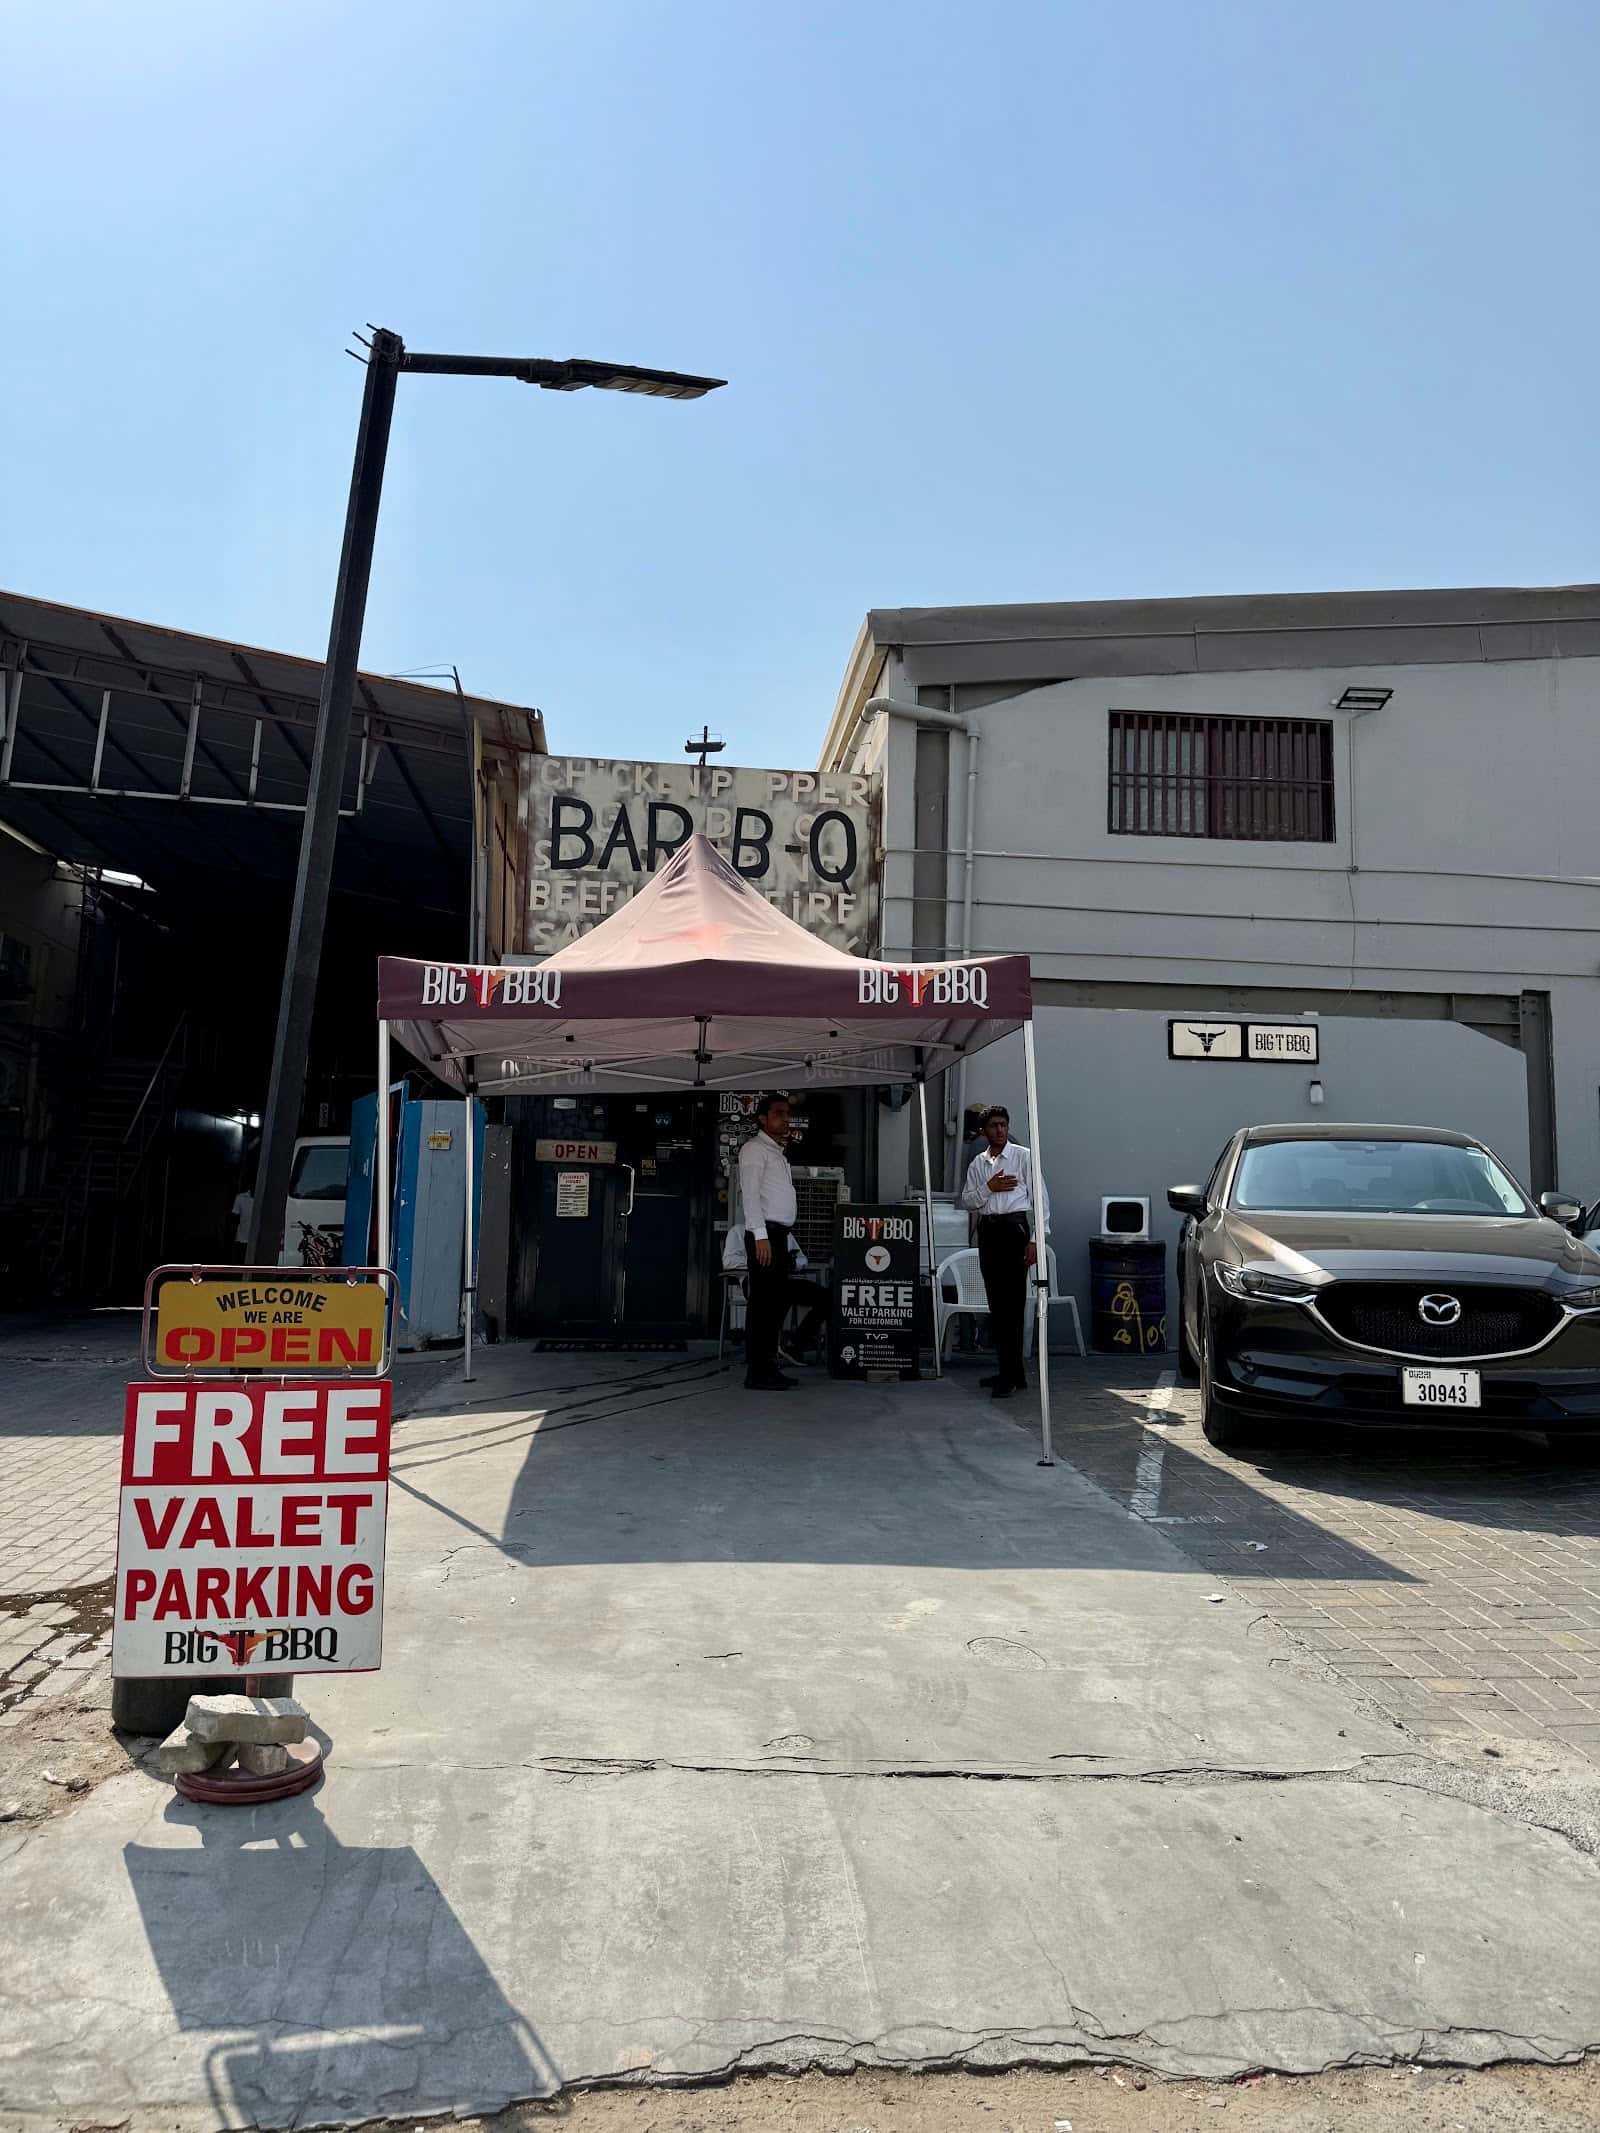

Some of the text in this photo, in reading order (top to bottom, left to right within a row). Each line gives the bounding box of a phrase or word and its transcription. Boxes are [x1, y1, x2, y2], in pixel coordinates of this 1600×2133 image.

[541, 758, 870, 808] CHCKEN PPPER
[421, 966, 562, 1009] BIG T BBQ
[858, 966, 990, 1009] BIG T BBQ
[1255, 1033, 1311, 1054] BIG T BBQ
[555, 1144, 598, 1160] OPEN
[843, 1216, 914, 1243] BIG T BBQ
[216, 1286, 328, 1313] WELCOME
[841, 1285, 913, 1307] FREE
[244, 1310, 303, 1324] WE ARE
[841, 1307, 913, 1318] VALET PARKING
[849, 1317, 903, 1326] FOR CUSTOMERS
[164, 1327, 373, 1363] OPEN
[1459, 1372, 1469, 1384] T
[1418, 1384, 1467, 1403] 30943
[132, 1388, 381, 1478] FREE
[133, 1494, 373, 1550] VALET
[123, 1563, 374, 1621] PARKING
[164, 1626, 340, 1665] BIG T BBQ
